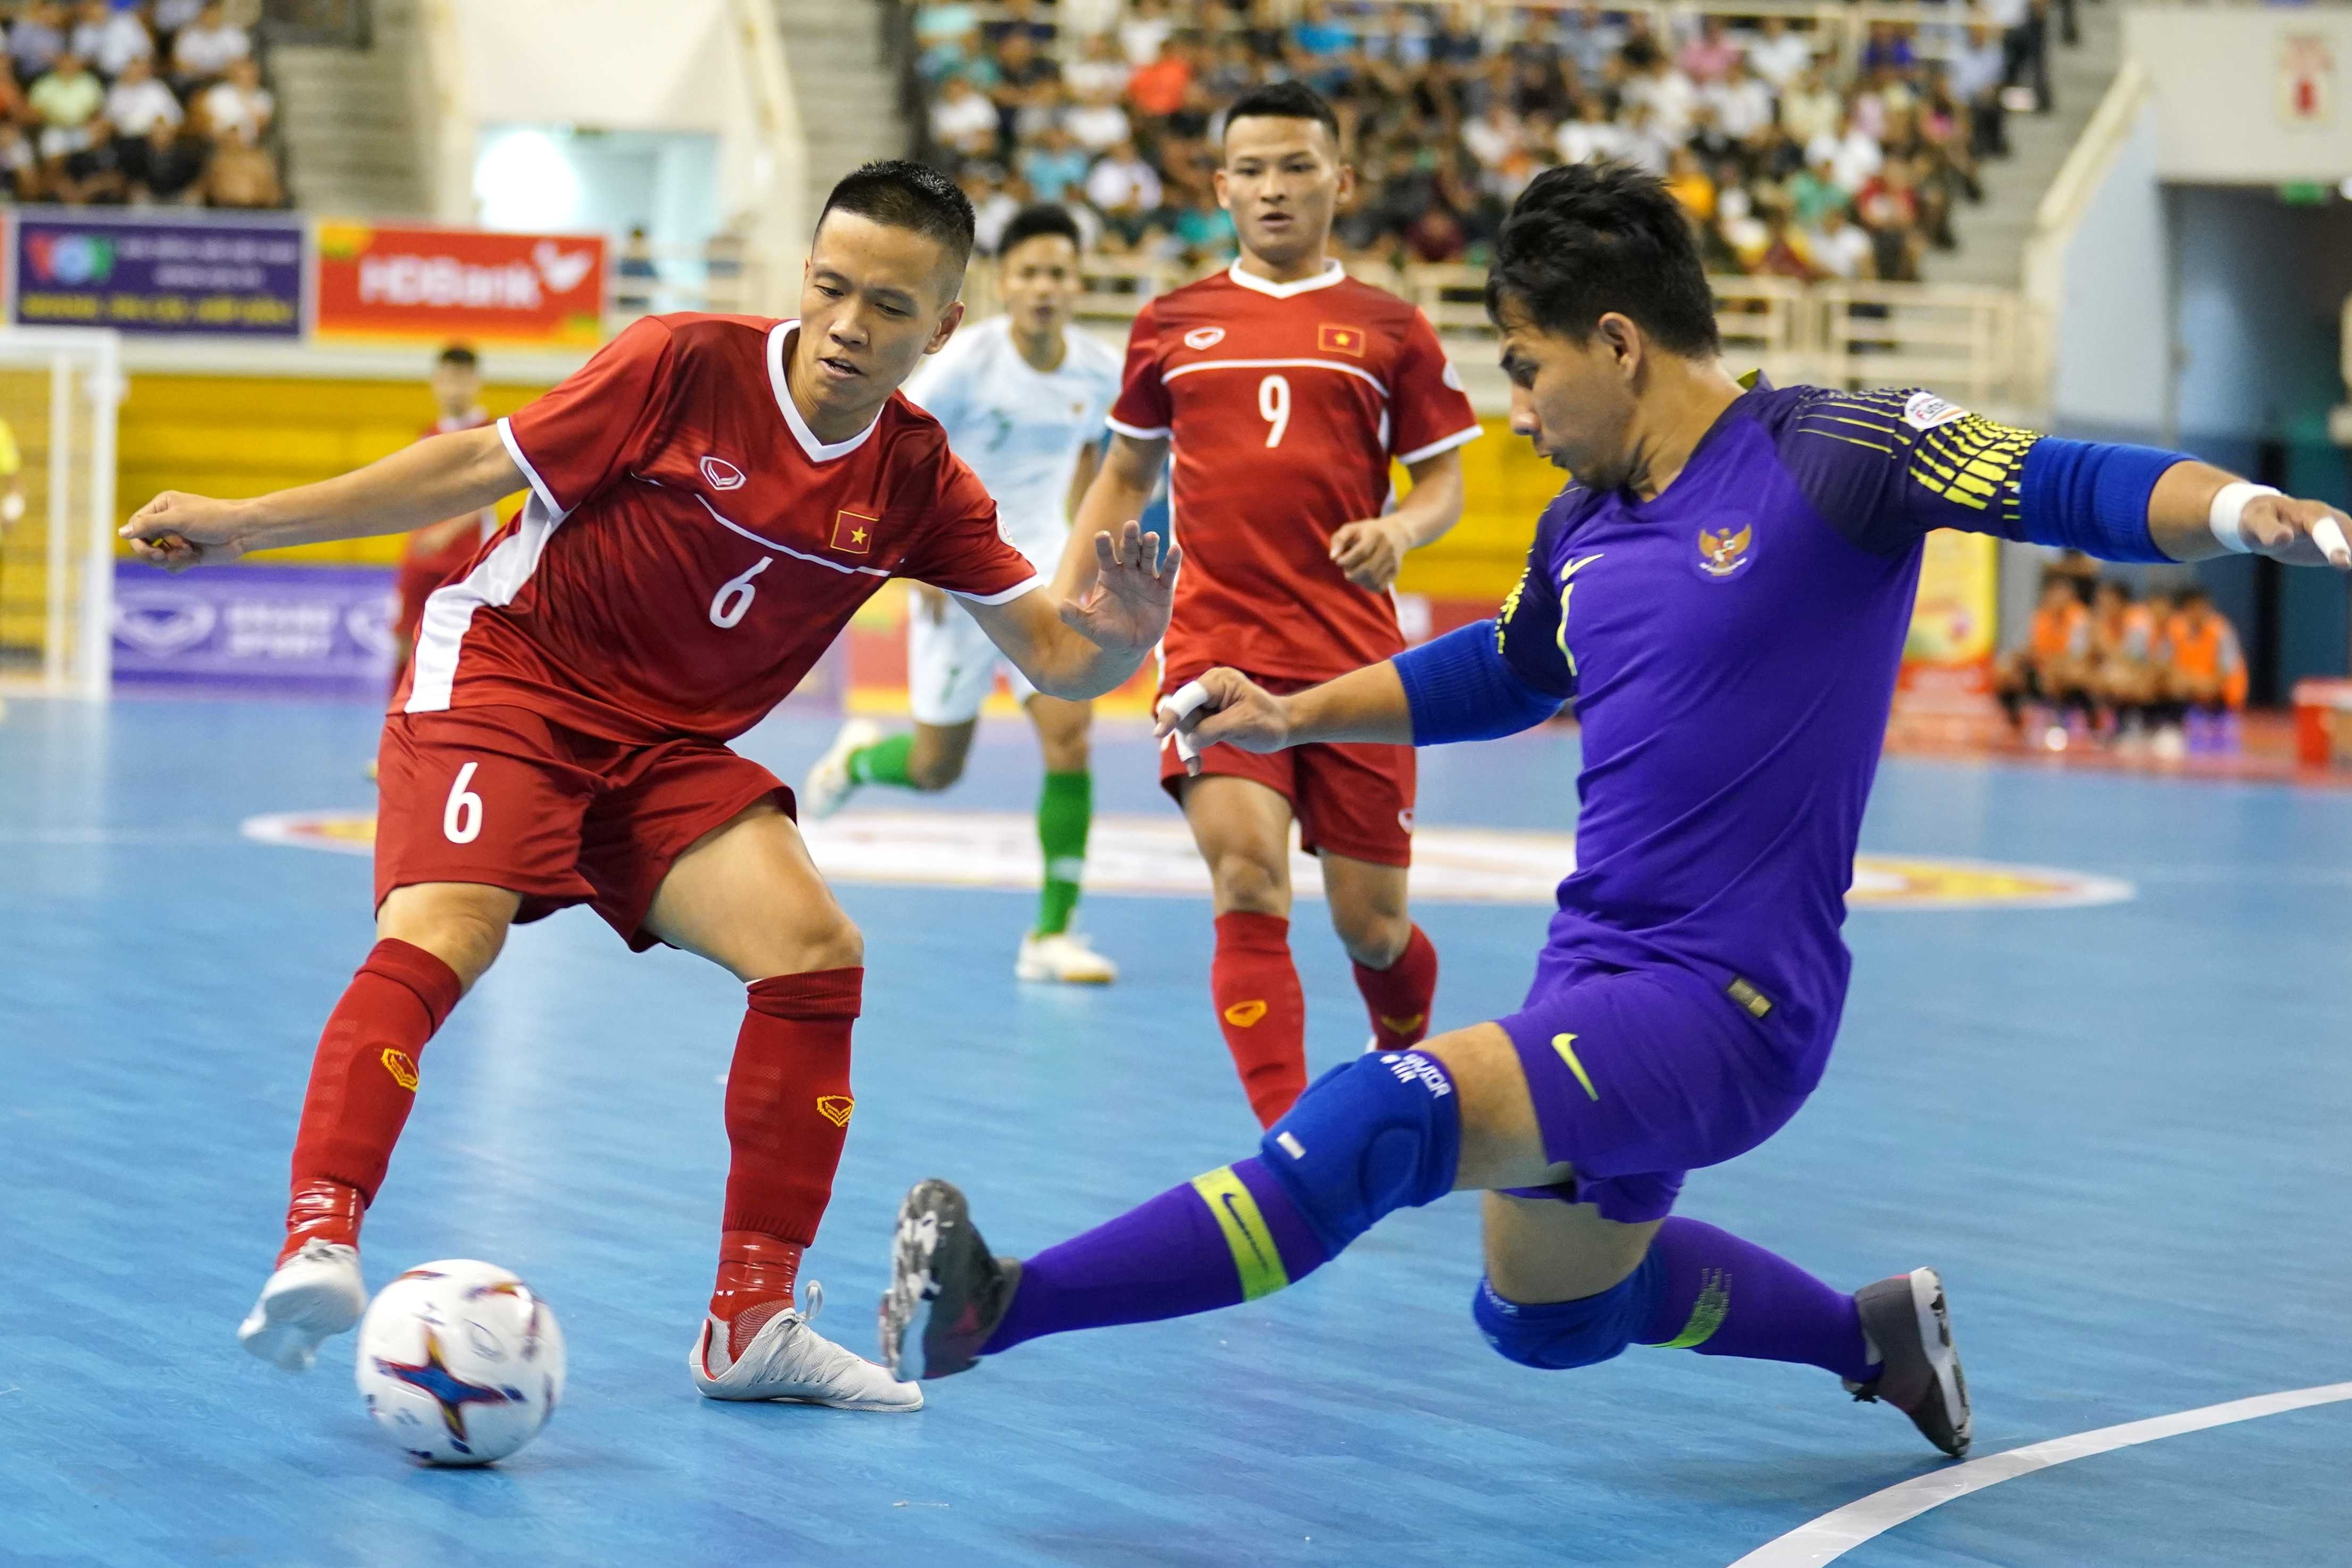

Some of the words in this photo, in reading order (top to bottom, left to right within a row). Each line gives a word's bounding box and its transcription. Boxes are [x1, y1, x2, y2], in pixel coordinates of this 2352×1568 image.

[1258, 374, 1291, 448] 9
[709, 556, 774, 628] 6
[443, 761, 483, 844] 6
